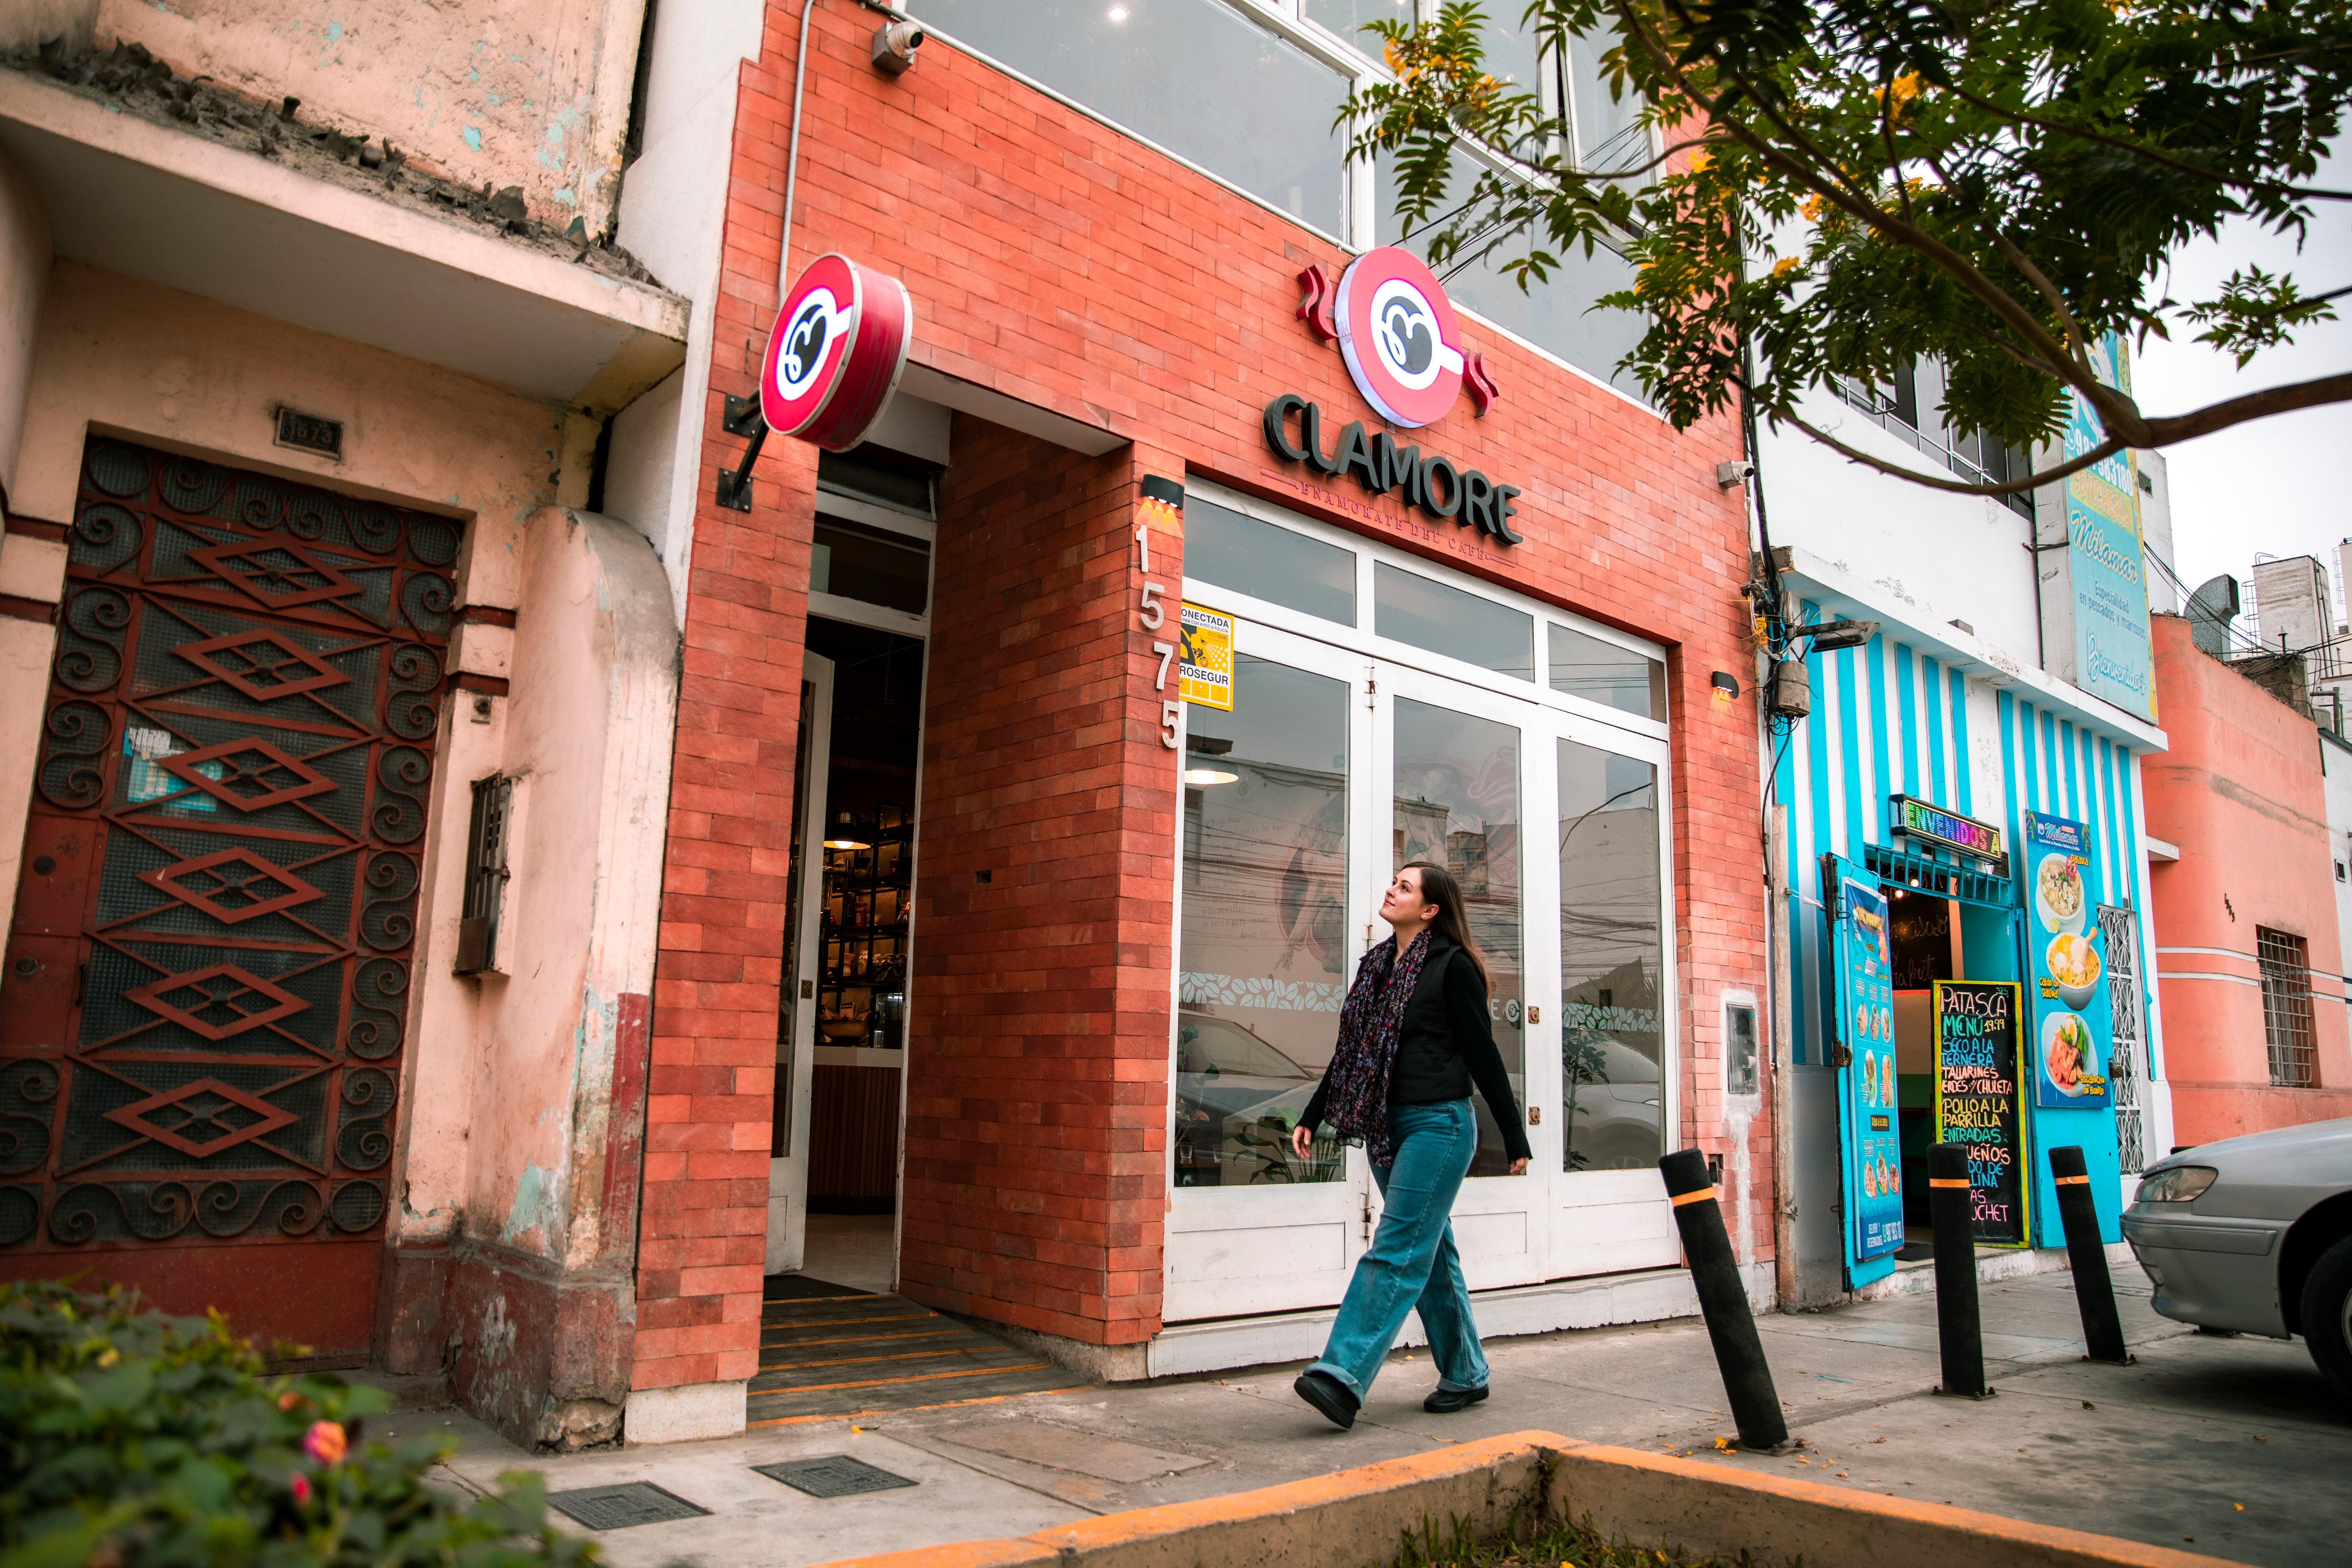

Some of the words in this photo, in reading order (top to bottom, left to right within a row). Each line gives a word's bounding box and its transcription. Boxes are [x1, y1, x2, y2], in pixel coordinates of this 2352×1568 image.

[1263, 394, 1524, 546] CLAMORE
[1301, 481, 1403, 531] ENAMORATE
[1411, 524, 1440, 544] DEL
[1448, 537, 1484, 560] CAFE
[2071, 509, 2137, 585] Milamar
[2095, 579, 2129, 615] Especialidad
[1181, 609, 1229, 628] ONECTADA
[2079, 591, 2087, 606] en
[2089, 596, 2114, 622] pescados
[2116, 613, 2120, 627] y
[2122, 615, 2145, 640] mariscos
[1136, 525, 1181, 749] 1575
[1208, 631, 1227, 640] 513-8686
[2087, 628, 2145, 695] Bienvenidos
[1180, 666, 1228, 685] ROSEGUR
[1907, 804, 1987, 851] ENVENIDOS
[2045, 822, 2079, 845] Milamar
[1940, 987, 2007, 1017] PATASCA
[1943, 1015, 1983, 1037] MENÚ
[1984, 1019, 2004, 1032] 19.99
[1943, 1036, 1969, 1053] SECO
[1972, 1037, 1979, 1052] A
[1982, 1038, 1994, 1054] LA
[1941, 1052, 1994, 1067] TERNERA
[1942, 1080, 1968, 1093] ERDES
[1977, 1079, 2012, 1095] CHULETA
[1942, 1098, 1979, 1114] POLLO
[1980, 1098, 1990, 1113] A
[1992, 1098, 2009, 1114] LA
[1942, 1112, 2002, 1128] PARRILLA
[1966, 1143, 2011, 1165] UEÑOS
[1969, 1172, 1998, 1188] LINA
[1987, 1162, 2003, 1176] DE
